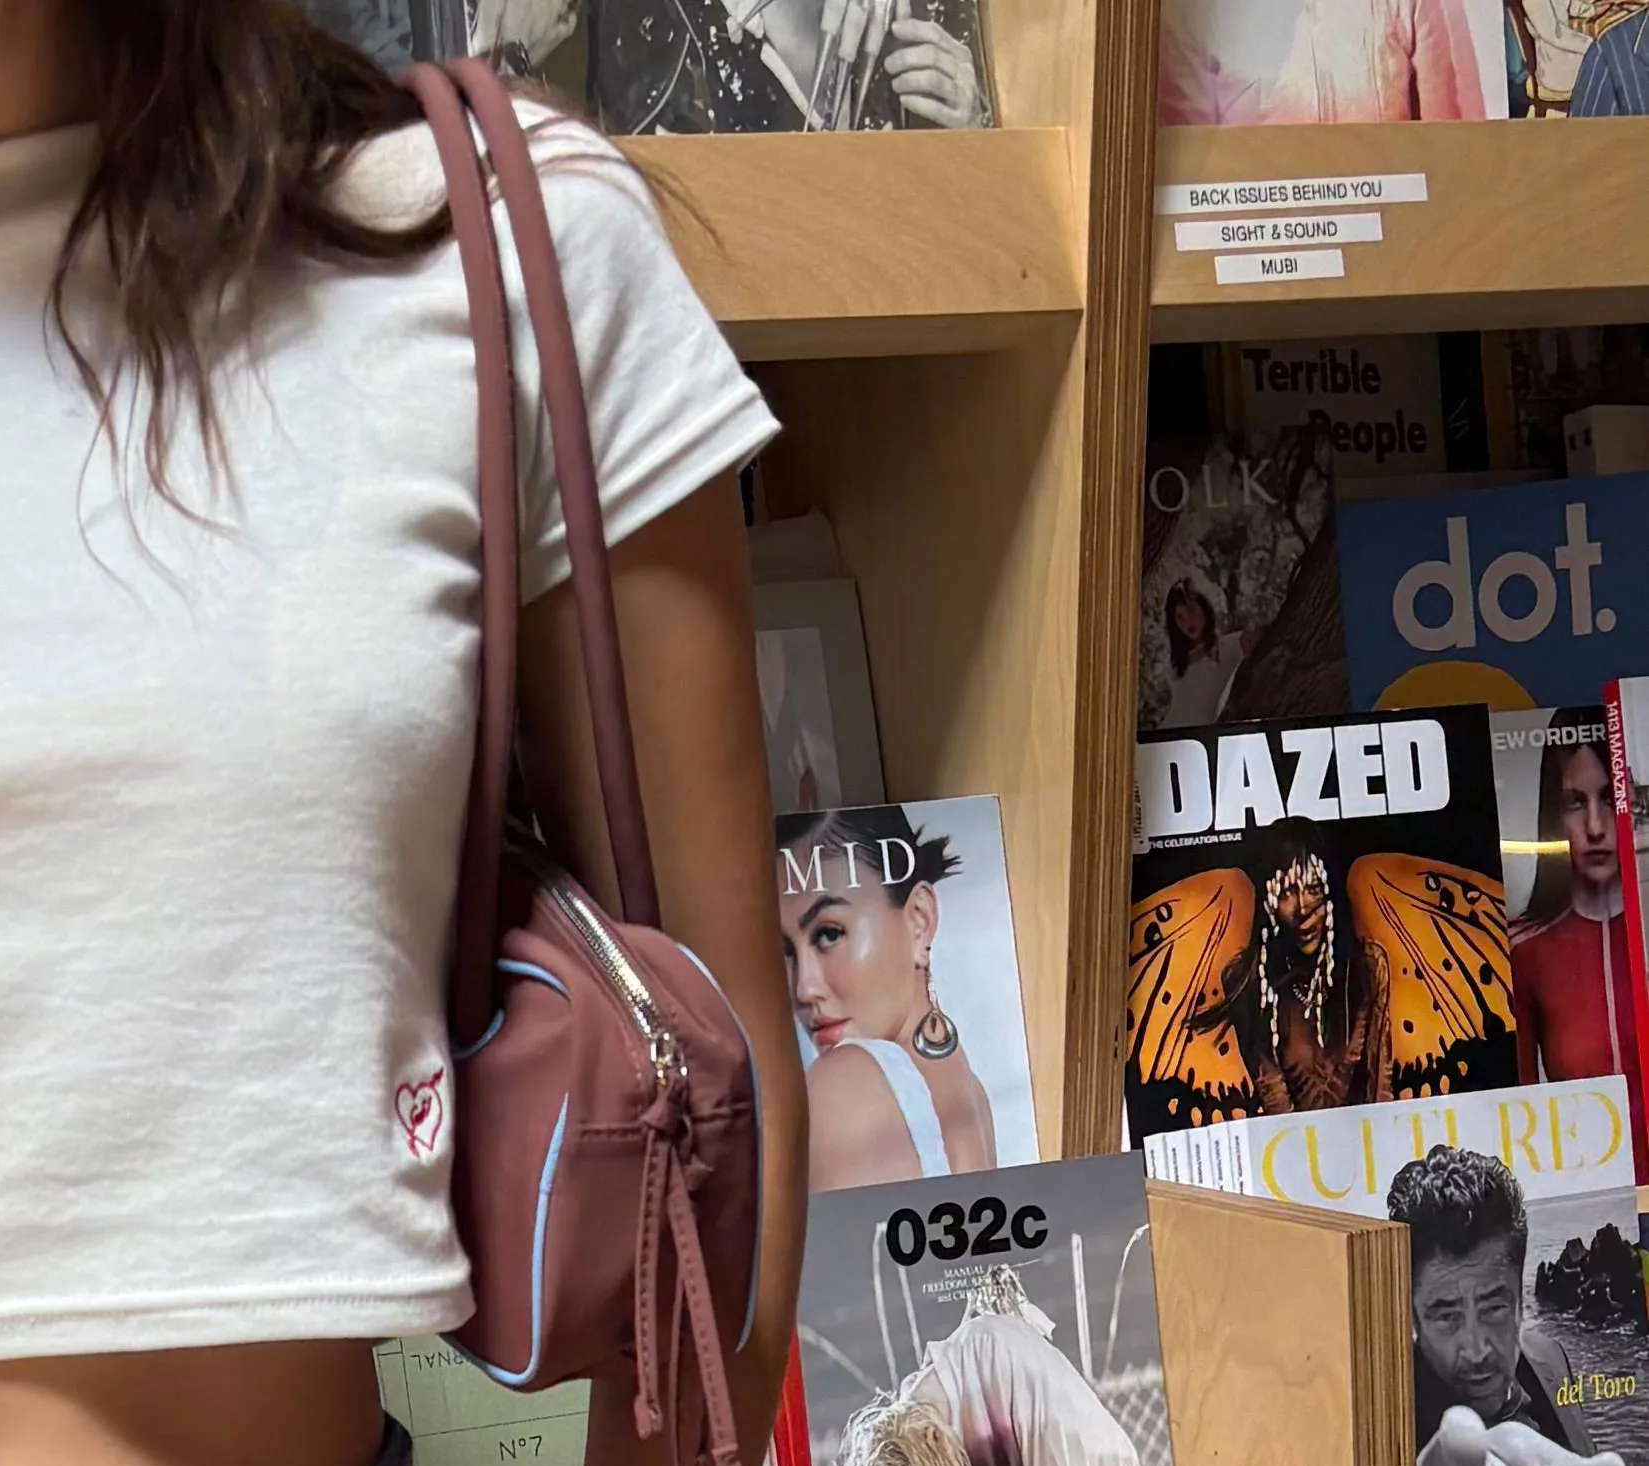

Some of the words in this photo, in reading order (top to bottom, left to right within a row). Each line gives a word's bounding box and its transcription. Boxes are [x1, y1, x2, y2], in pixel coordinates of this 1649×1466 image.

[1188, 188, 1232, 207] BACK
[1233, 186, 1289, 205] ISSUES
[1291, 183, 1348, 203] BEHIND
[1349, 180, 1383, 200] YOU
[1220, 223, 1267, 243] SIGHT
[1270, 223, 1282, 240] &
[1283, 220, 1339, 241] SOUND
[1260, 257, 1299, 276] MUBI
[1243, 348, 1382, 395] Terrible
[1307, 408, 1428, 464] People
[1392, 502, 1618, 653] dot.
[1528, 723, 1607, 748] ORDER
[1136, 718, 1452, 838] DAZED
[1608, 733, 1629, 815] MAGAZINE
[885, 1195, 1050, 1267] 032c
[1556, 1374, 1584, 1408] del
[1588, 1372, 1637, 1400] Toro
